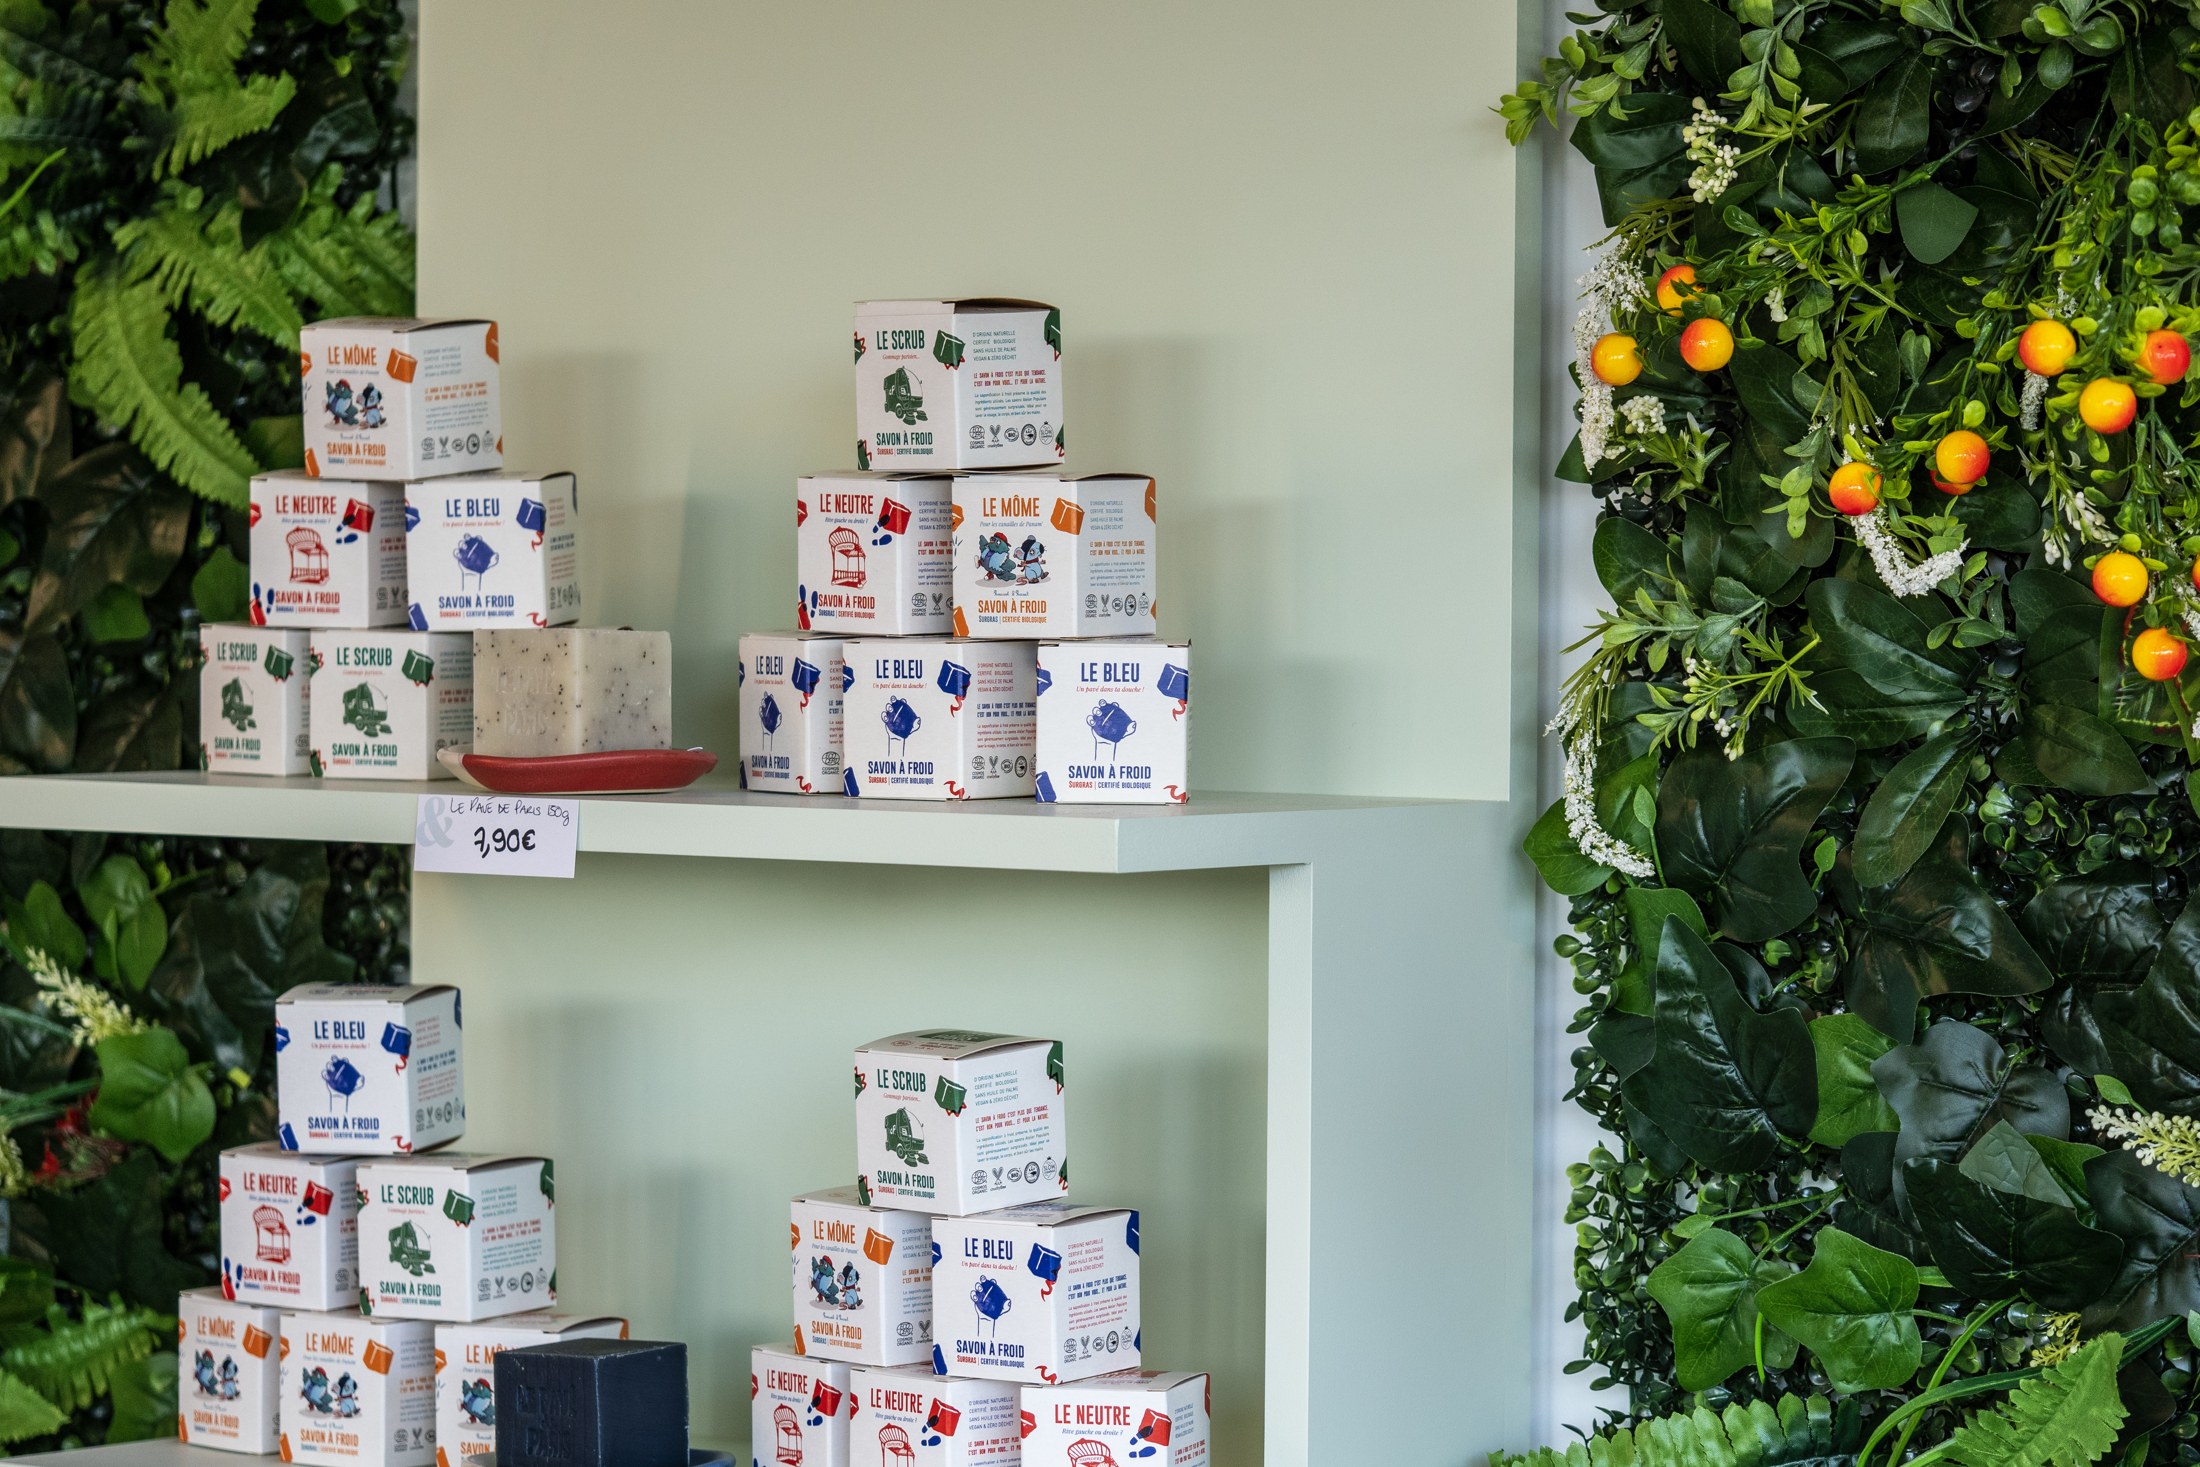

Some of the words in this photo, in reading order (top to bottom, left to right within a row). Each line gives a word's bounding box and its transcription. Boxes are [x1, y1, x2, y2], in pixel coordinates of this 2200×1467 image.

[876, 330, 889, 350] LE
[891, 329, 925, 350] SCRUB
[328, 346, 340, 365] LE
[344, 344, 377, 366] MÔME
[876, 432, 901, 446] SAVON
[903, 430, 909, 445] À
[910, 432, 933, 445] FROID
[327, 442, 353, 456] SAVON
[355, 441, 361, 456] À
[363, 444, 386, 457] FROID
[276, 495, 288, 514] LE
[293, 496, 337, 515] NEUTRE
[446, 499, 462, 518] LE
[467, 498, 500, 518] BLEU
[820, 493, 831, 513] LE
[835, 494, 874, 515] NEUTRE
[983, 498, 997, 517] LE
[1001, 495, 1040, 517] MÔME
[275, 591, 303, 604] SAVON
[306, 588, 313, 604] À
[315, 591, 340, 604] FROID
[438, 595, 472, 608] SAVON
[475, 593, 482, 607] À
[486, 595, 514, 607] FROID
[818, 594, 843, 608] SAVON
[845, 593, 851, 608] À
[853, 595, 875, 610] FROID
[978, 600, 1007, 613] SAVON
[1011, 598, 1017, 613] À
[1019, 600, 1047, 613] FROID
[217, 642, 227, 661] LE
[229, 642, 258, 662] SCRUB
[337, 647, 351, 665] LE
[354, 647, 392, 666] SCRUB
[756, 656, 764, 675] LE
[766, 656, 783, 675] BLEU
[876, 660, 889, 679] LE
[894, 659, 923, 679] BLEU
[1081, 662, 1098, 682] LE
[1103, 662, 1140, 682] BLEU
[214, 736, 234, 750] SAVON
[236, 736, 240, 750] À
[241, 738, 261, 751] FROID
[332, 744, 360, 757] SAVON
[364, 741, 370, 757] À
[372, 744, 398, 757] FROID
[751, 755, 767, 769] SAVON
[768, 754, 772, 769] À
[774, 756, 790, 770] FROID
[868, 761, 896, 775] SAVON
[899, 759, 904, 774] À
[908, 762, 934, 775] FROID
[1068, 765, 1104, 779] SAVON
[1109, 764, 1115, 779] À
[1120, 766, 1151, 779] FROID
[1098, 780, 1120, 789] CERTIFIÉ
[450, 797, 465, 814] LE
[498, 803, 510, 814] DE
[514, 800, 541, 816] PARIS
[473, 826, 536, 859] 7,90€
[314, 1021, 329, 1039] LE
[333, 1021, 365, 1039] BLEU
[877, 1069, 890, 1088] LE
[892, 1070, 926, 1093] SCRUB
[308, 1117, 339, 1130] SAVON
[342, 1115, 349, 1129] À
[352, 1117, 379, 1130] FROID
[244, 1172, 255, 1191] LE
[259, 1174, 298, 1196] NEUTRE
[877, 1170, 902, 1186] SAVON
[904, 1170, 910, 1187] À
[912, 1175, 935, 1189] FROID
[381, 1184, 392, 1203] LE
[397, 1185, 434, 1205] SCRUB
[813, 1220, 824, 1240] LE
[827, 1220, 856, 1244] MÔME
[964, 1237, 978, 1258] LE
[983, 1239, 1013, 1260] BLEU
[244, 1268, 268, 1281] SAVON
[270, 1268, 275, 1282] À
[278, 1271, 300, 1285] FROID
[380, 1280, 407, 1294] SAVON
[409, 1280, 415, 1295] À
[417, 1283, 441, 1297] FROID
[197, 1316, 206, 1336] LE
[209, 1316, 235, 1340] MÔME
[811, 1320, 833, 1336] SAVON
[835, 1321, 840, 1337] À
[842, 1325, 862, 1340] FROID
[306, 1332, 318, 1351] LE
[321, 1332, 354, 1356] MÔME
[465, 1344, 480, 1363] LE
[956, 1340, 985, 1355] SAVON
[989, 1340, 995, 1356] À
[998, 1344, 1025, 1359] FROID
[767, 1369, 776, 1389] LE
[778, 1370, 808, 1395] NEUTRE
[870, 1388, 882, 1407] LE
[885, 1389, 923, 1414] NEUTRE
[193, 1409, 212, 1423] SAVON
[214, 1410, 218, 1424] À
[220, 1413, 239, 1428] FROID
[1055, 1404, 1071, 1424] LE
[1076, 1405, 1131, 1426] NEUTRE
[300, 1429, 325, 1443] SAVON
[328, 1429, 333, 1444] À
[336, 1433, 359, 1447] FROID
[1103, 1428, 1119, 1436] droite
[460, 1441, 490, 1455] SAVON
